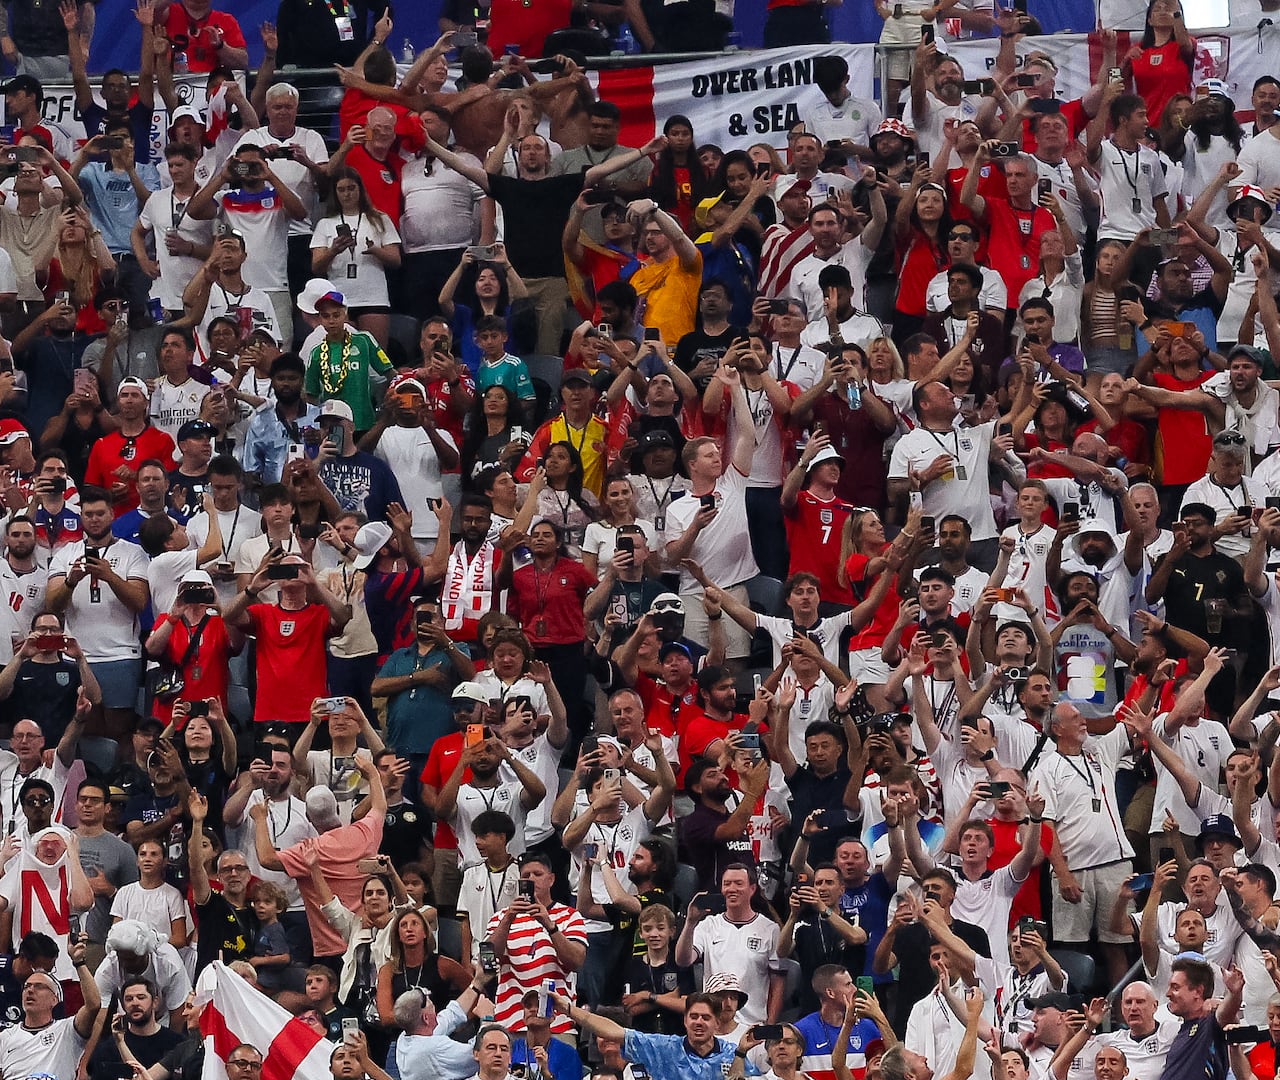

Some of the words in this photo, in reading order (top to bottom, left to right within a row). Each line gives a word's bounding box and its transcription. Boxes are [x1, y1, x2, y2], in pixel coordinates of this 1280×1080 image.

[691, 67, 759, 98] OVER
[763, 58, 812, 90] LAN
[729, 111, 749, 137] &
[753, 102, 801, 135] SEA
[821, 525, 833, 545] 7
[9, 590, 24, 614] 18
[1194, 582, 1204, 602] 7
